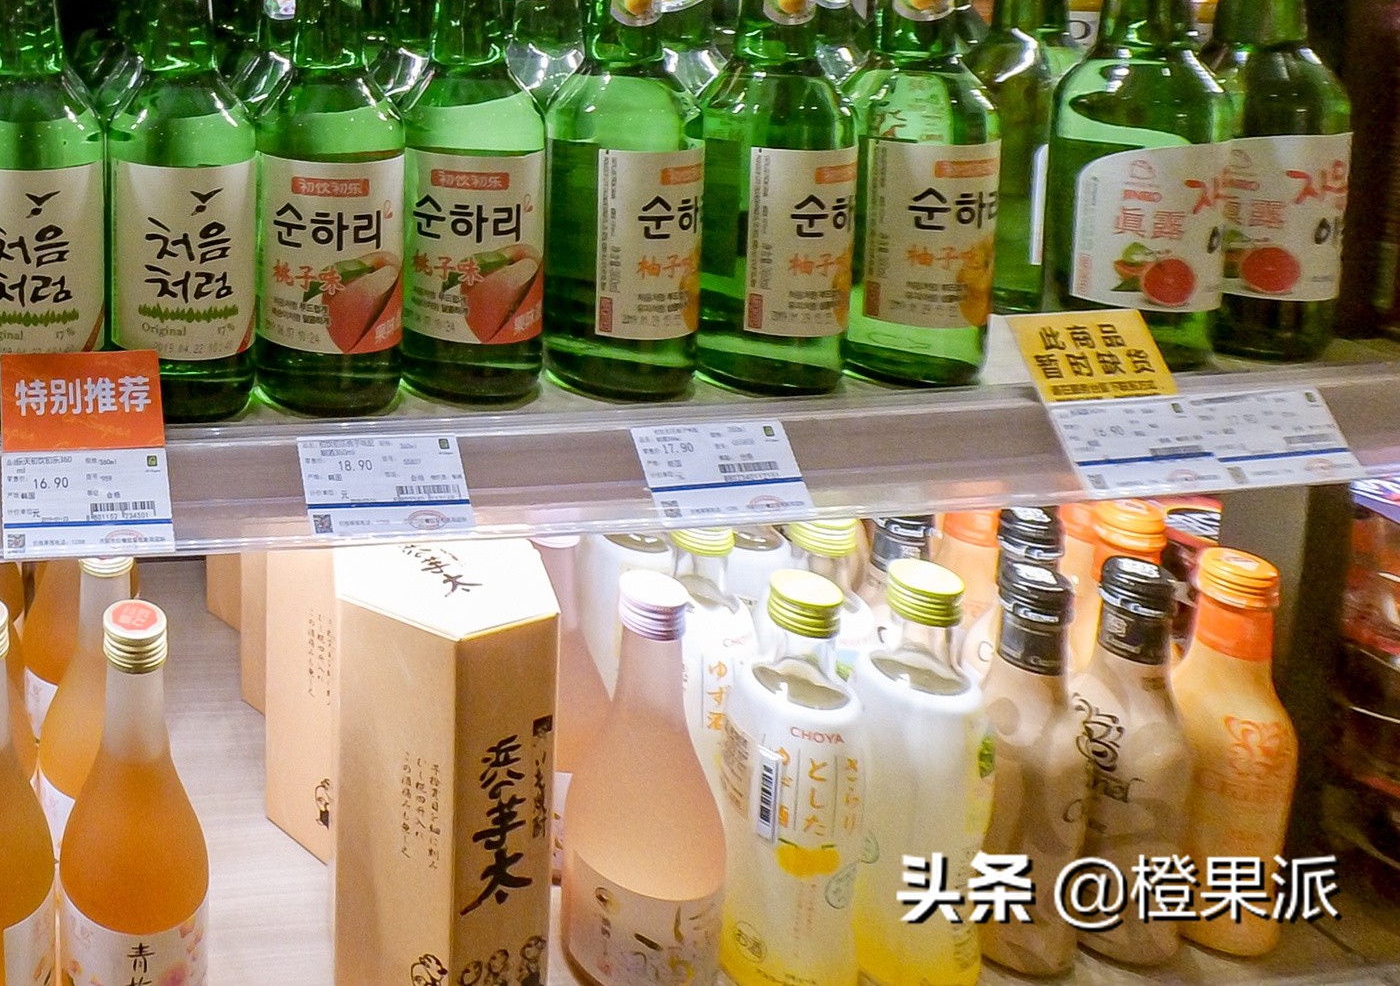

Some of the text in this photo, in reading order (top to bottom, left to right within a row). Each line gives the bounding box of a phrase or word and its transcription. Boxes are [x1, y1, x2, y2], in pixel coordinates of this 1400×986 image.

[300, 181, 362, 194] 初饮初乐
[439, 174, 502, 188] 初饮初乐
[273, 202, 383, 251] 순하리
[413, 194, 521, 243] 순하리
[146, 217, 231, 264] 처음
[273, 259, 345, 295] 桃子味
[412, 249, 485, 287] 桃子味
[144, 265, 234, 303] 처럼
[56, 328, 75, 340] 17%
[142, 322, 235, 336] Original 17%
[1039, 324, 1126, 350] 此商品
[1034, 349, 1155, 379] 暂时缺货
[15, 376, 151, 416] 特别推荐
[662, 442, 694, 454] 17.90
[338, 460, 372, 471] 18.90
[33, 477, 69, 489] 16.90
[790, 727, 845, 744] CHOYA
[805, 758, 827, 836] とした
